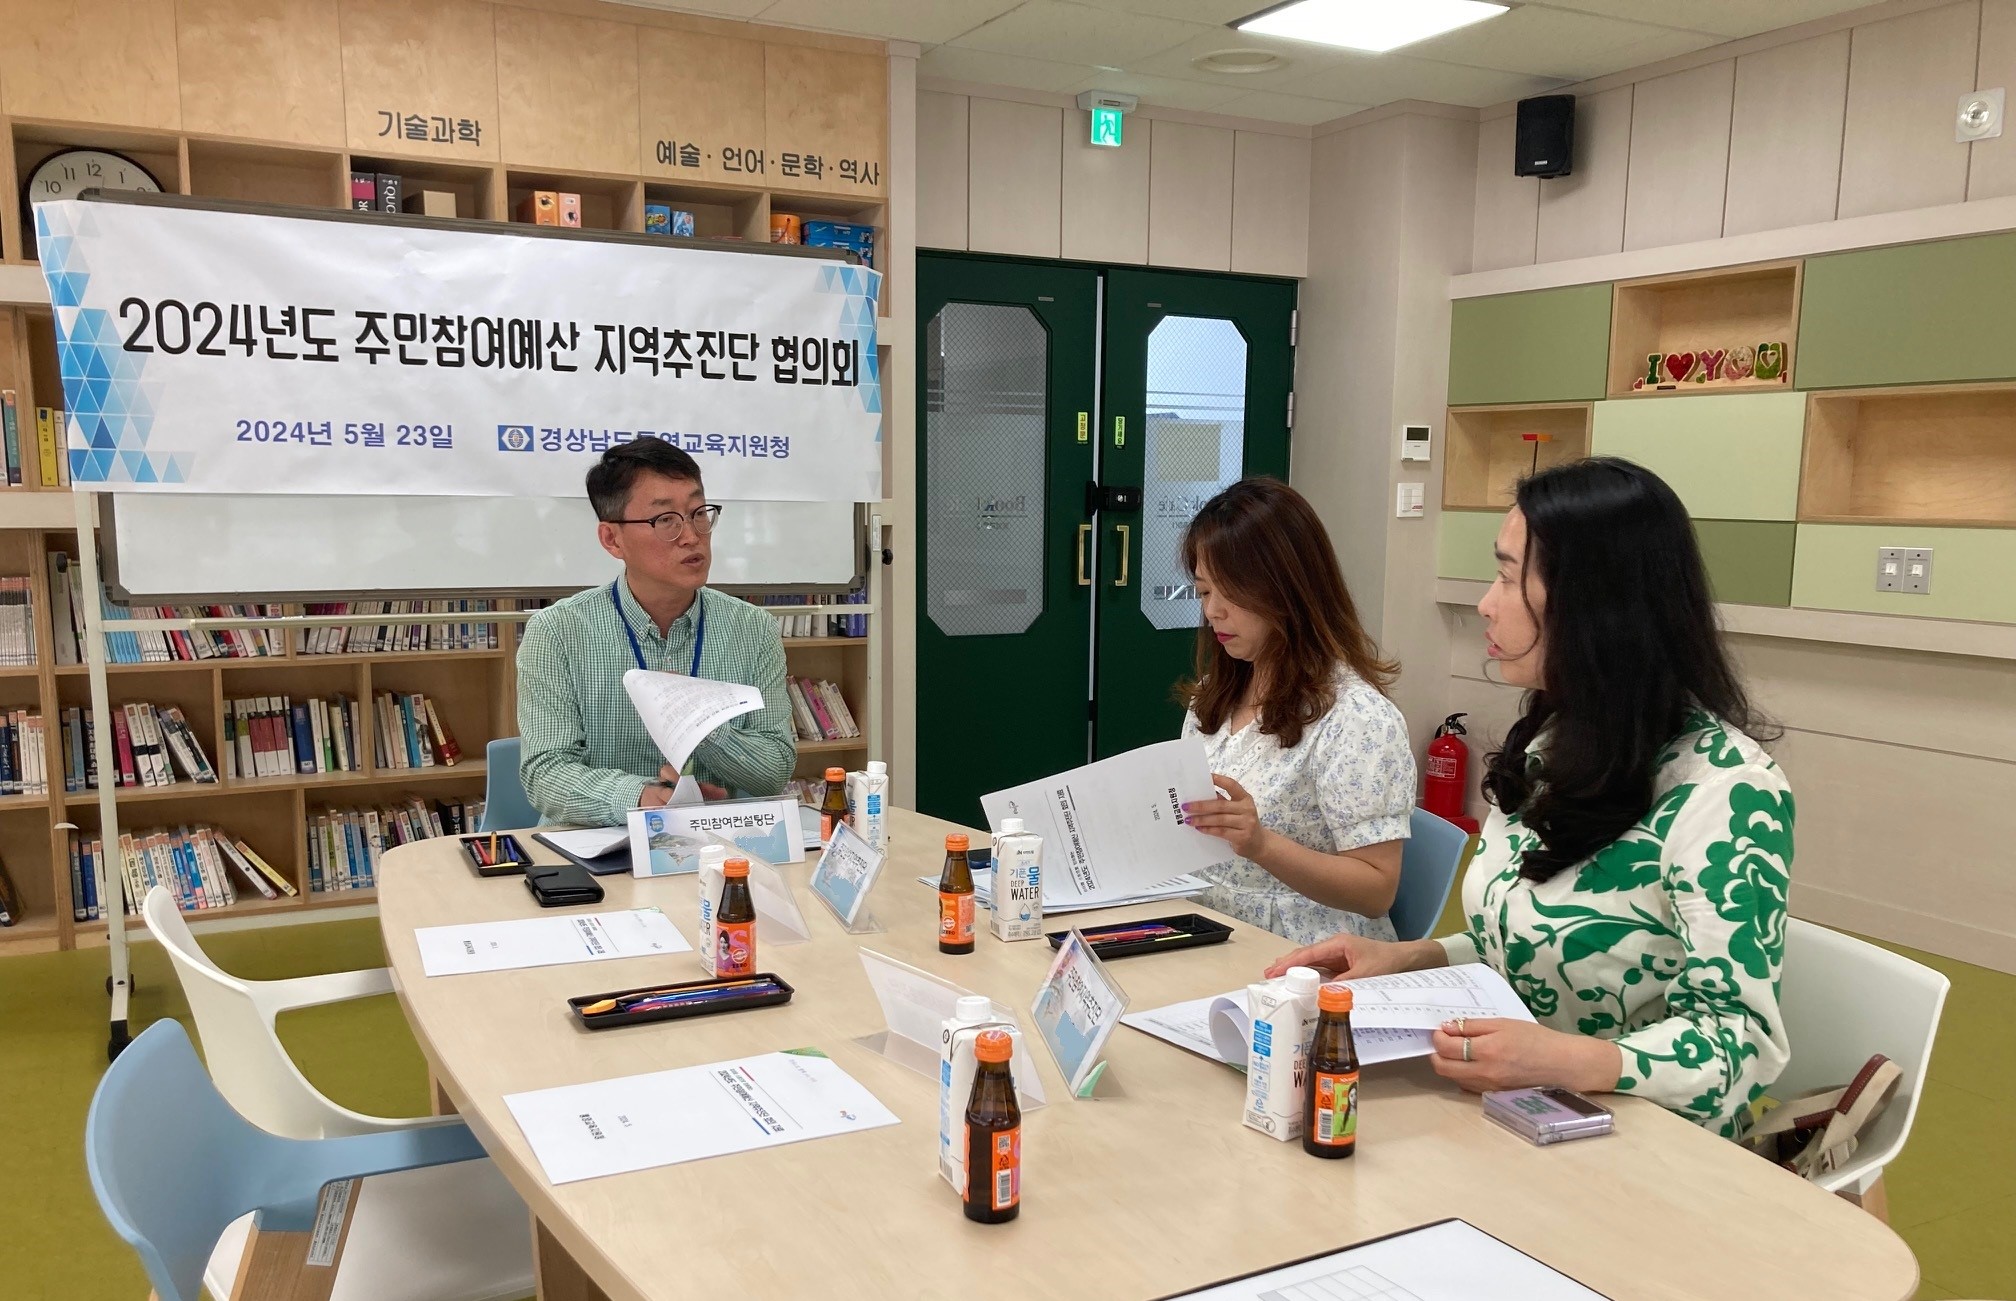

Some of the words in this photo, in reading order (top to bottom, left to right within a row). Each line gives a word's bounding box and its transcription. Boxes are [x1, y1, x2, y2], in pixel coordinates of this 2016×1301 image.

[377, 110, 482, 147] 기술과학
[63, 166, 76, 181] 11
[86, 162, 103, 178] 12
[43, 180, 62, 194] 10
[118, 296, 340, 363] 2024년도
[354, 309, 581, 374] 주민참여예산
[593, 323, 761, 382] 지역추진단
[771, 335, 860, 387] 협의회
[236, 418, 333, 447] 2024년
[344, 421, 386, 449] 5월
[395, 423, 454, 450] 23일
[689, 812, 776, 832] 주민참여컨설팅단
[1010, 880, 1025, 888] DEEP
[1010, 886, 1040, 901] WATER
